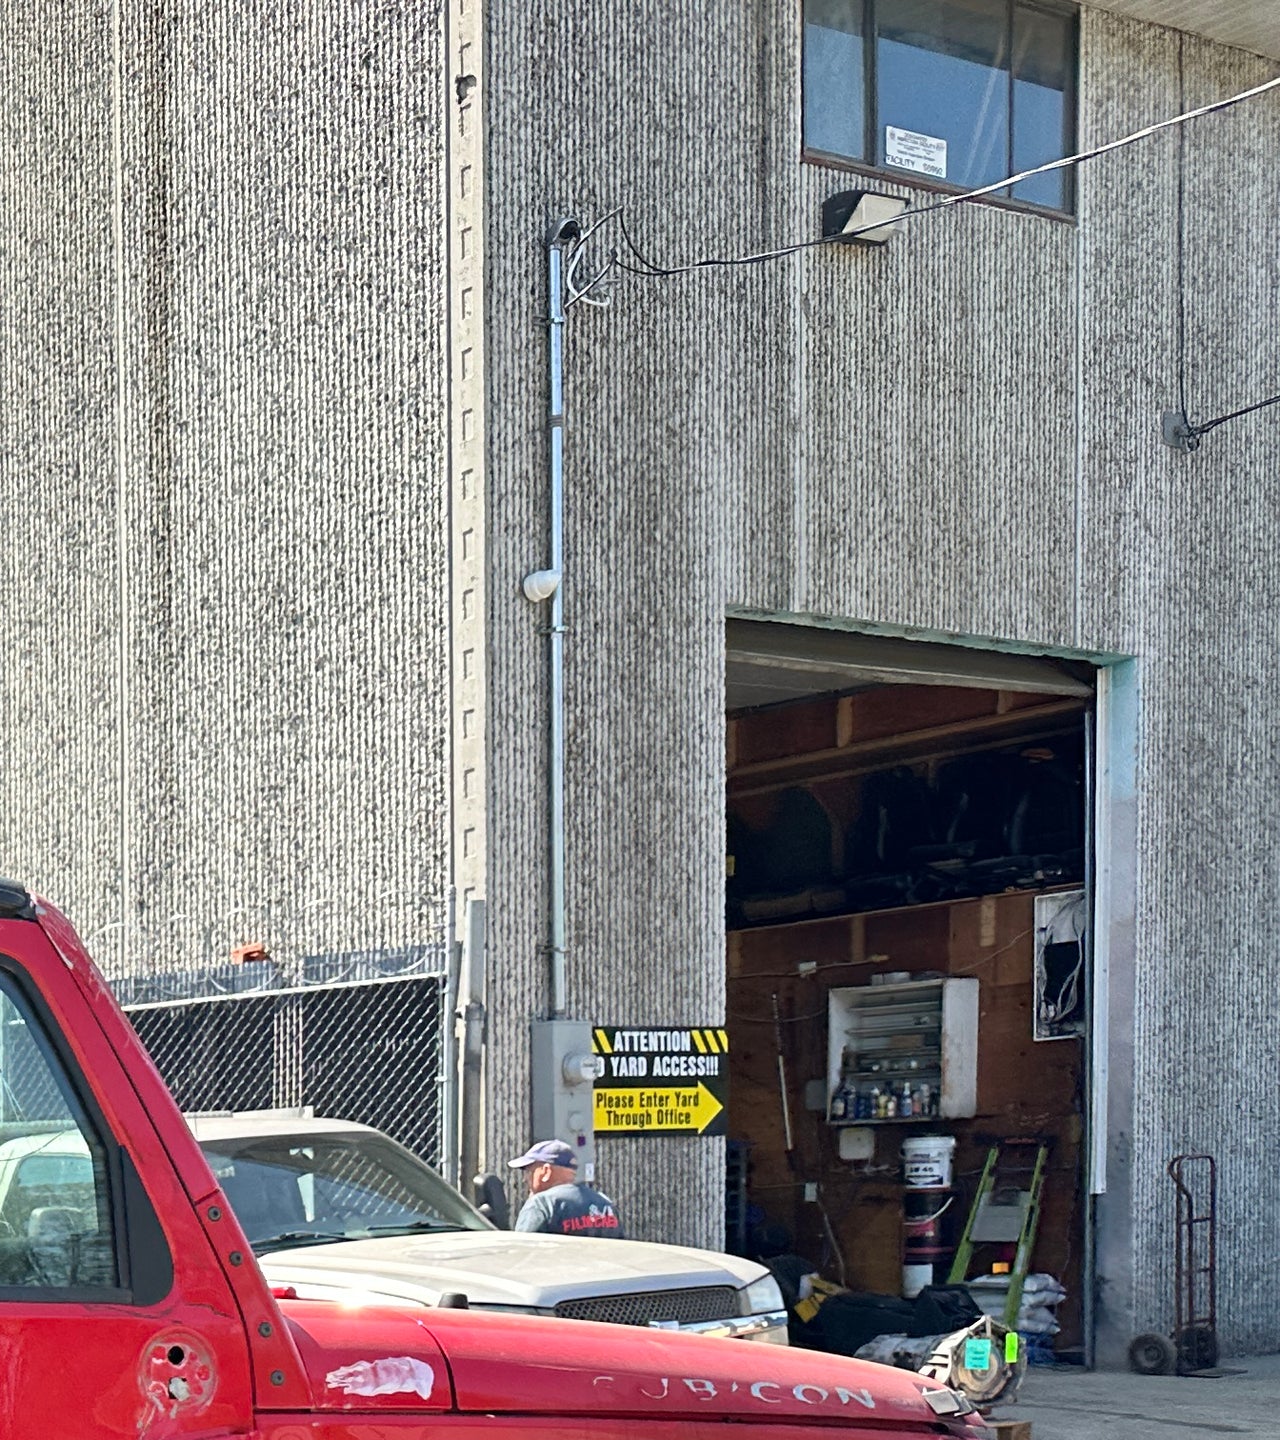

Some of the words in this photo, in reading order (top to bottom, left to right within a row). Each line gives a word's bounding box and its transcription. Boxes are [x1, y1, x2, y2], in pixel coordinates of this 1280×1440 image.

[613, 1031, 691, 1052] ATTENTION
[610, 1056, 648, 1077] YARD
[652, 1055, 719, 1077] ACCESS!!!
[596, 1092, 634, 1108] Please
[639, 1092, 670, 1108] Enter
[674, 1091, 699, 1108] Yard
[606, 1110, 652, 1128] Through
[656, 1109, 691, 1125] Office
